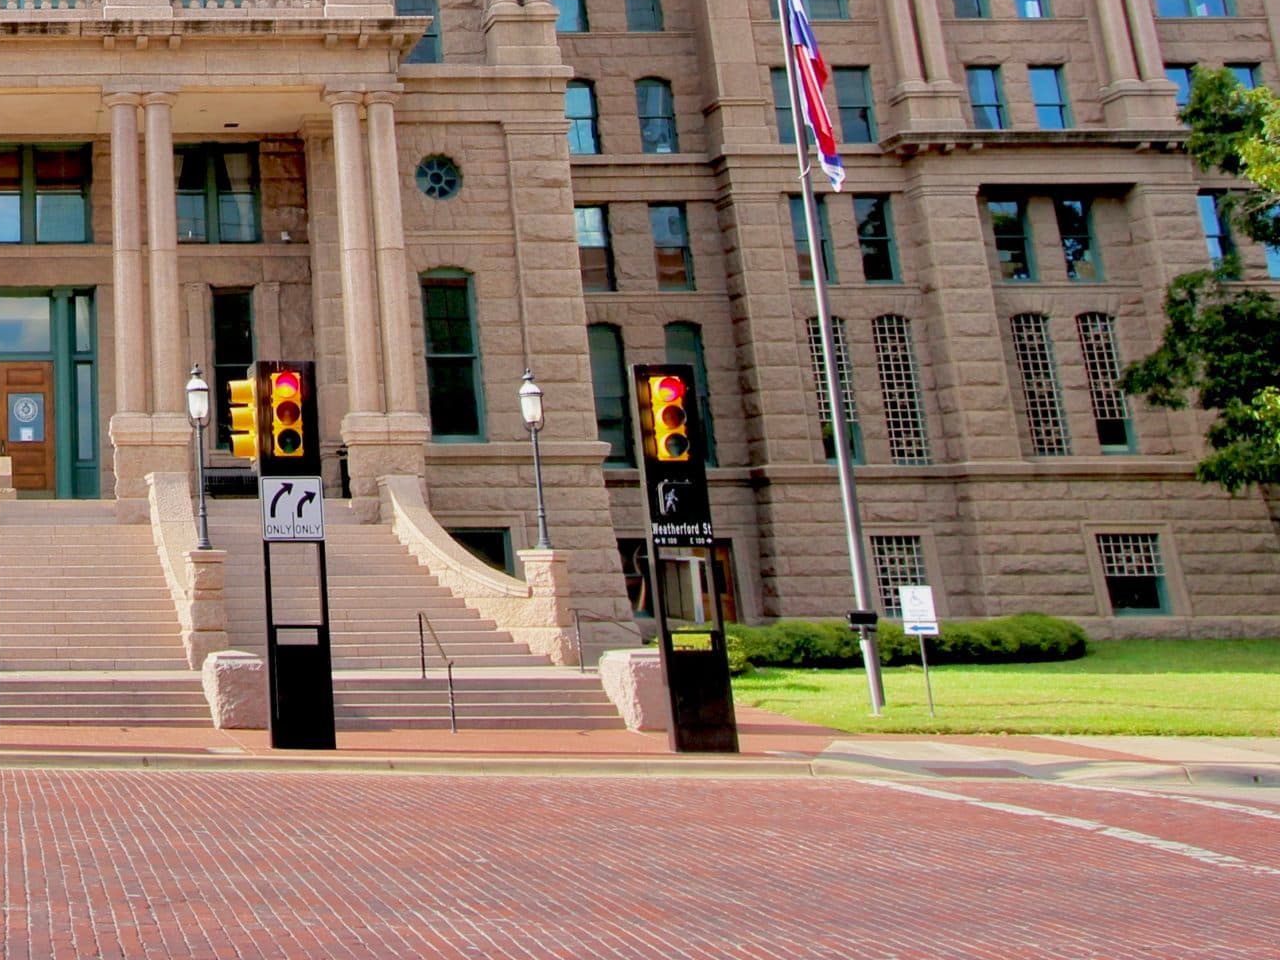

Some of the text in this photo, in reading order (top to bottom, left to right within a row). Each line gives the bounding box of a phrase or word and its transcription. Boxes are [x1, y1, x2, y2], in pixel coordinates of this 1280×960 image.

[266, 524, 292, 534] ONLY
[295, 524, 320, 534] ONLY
[651, 522, 712, 535] Weatherford St
